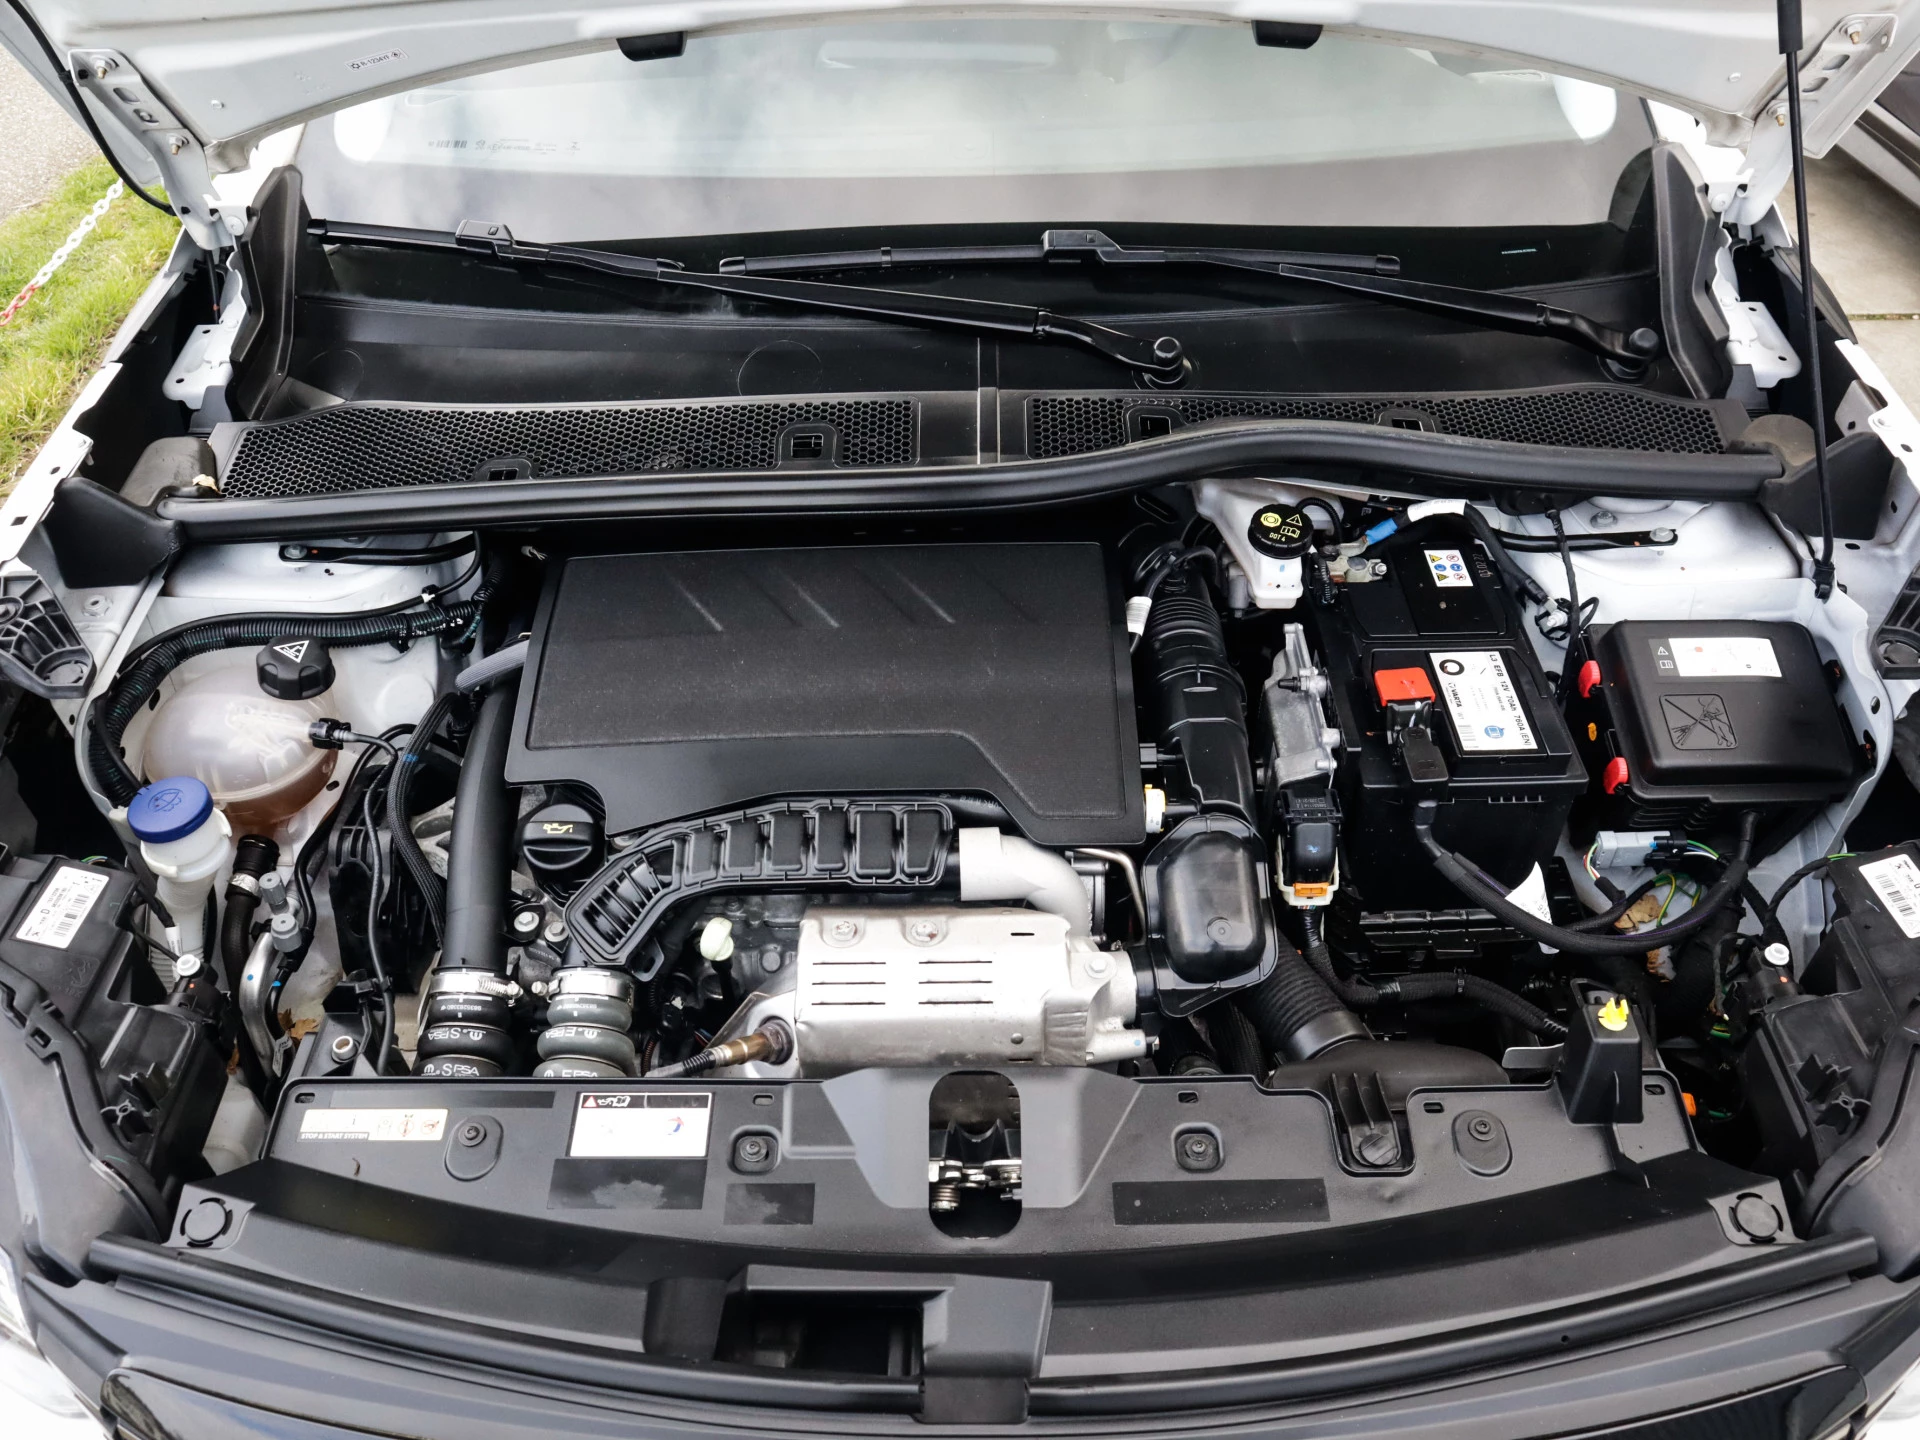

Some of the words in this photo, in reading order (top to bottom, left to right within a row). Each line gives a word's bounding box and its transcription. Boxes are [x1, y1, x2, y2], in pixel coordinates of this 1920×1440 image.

[1269, 532, 1281, 540] DOT
[1451, 688, 1462, 708] VARTA
[1489, 654, 1498, 662] L3
[1494, 665, 1504, 677] EFB
[1500, 680, 1511, 692] 12V
[1506, 695, 1517, 712] 70Ah
[1514, 715, 1526, 731] 760A
[1520, 732, 1532, 746] (EN)
[427, 1031, 449, 1040] PSA
[545, 1029, 565, 1039] PSA
[441, 1063, 453, 1077] S
[453, 1064, 480, 1077] PSA
[301, 1132, 318, 1140] STOP
[323, 1132, 344, 1140] START
[343, 1132, 369, 1140] SYSTEM
